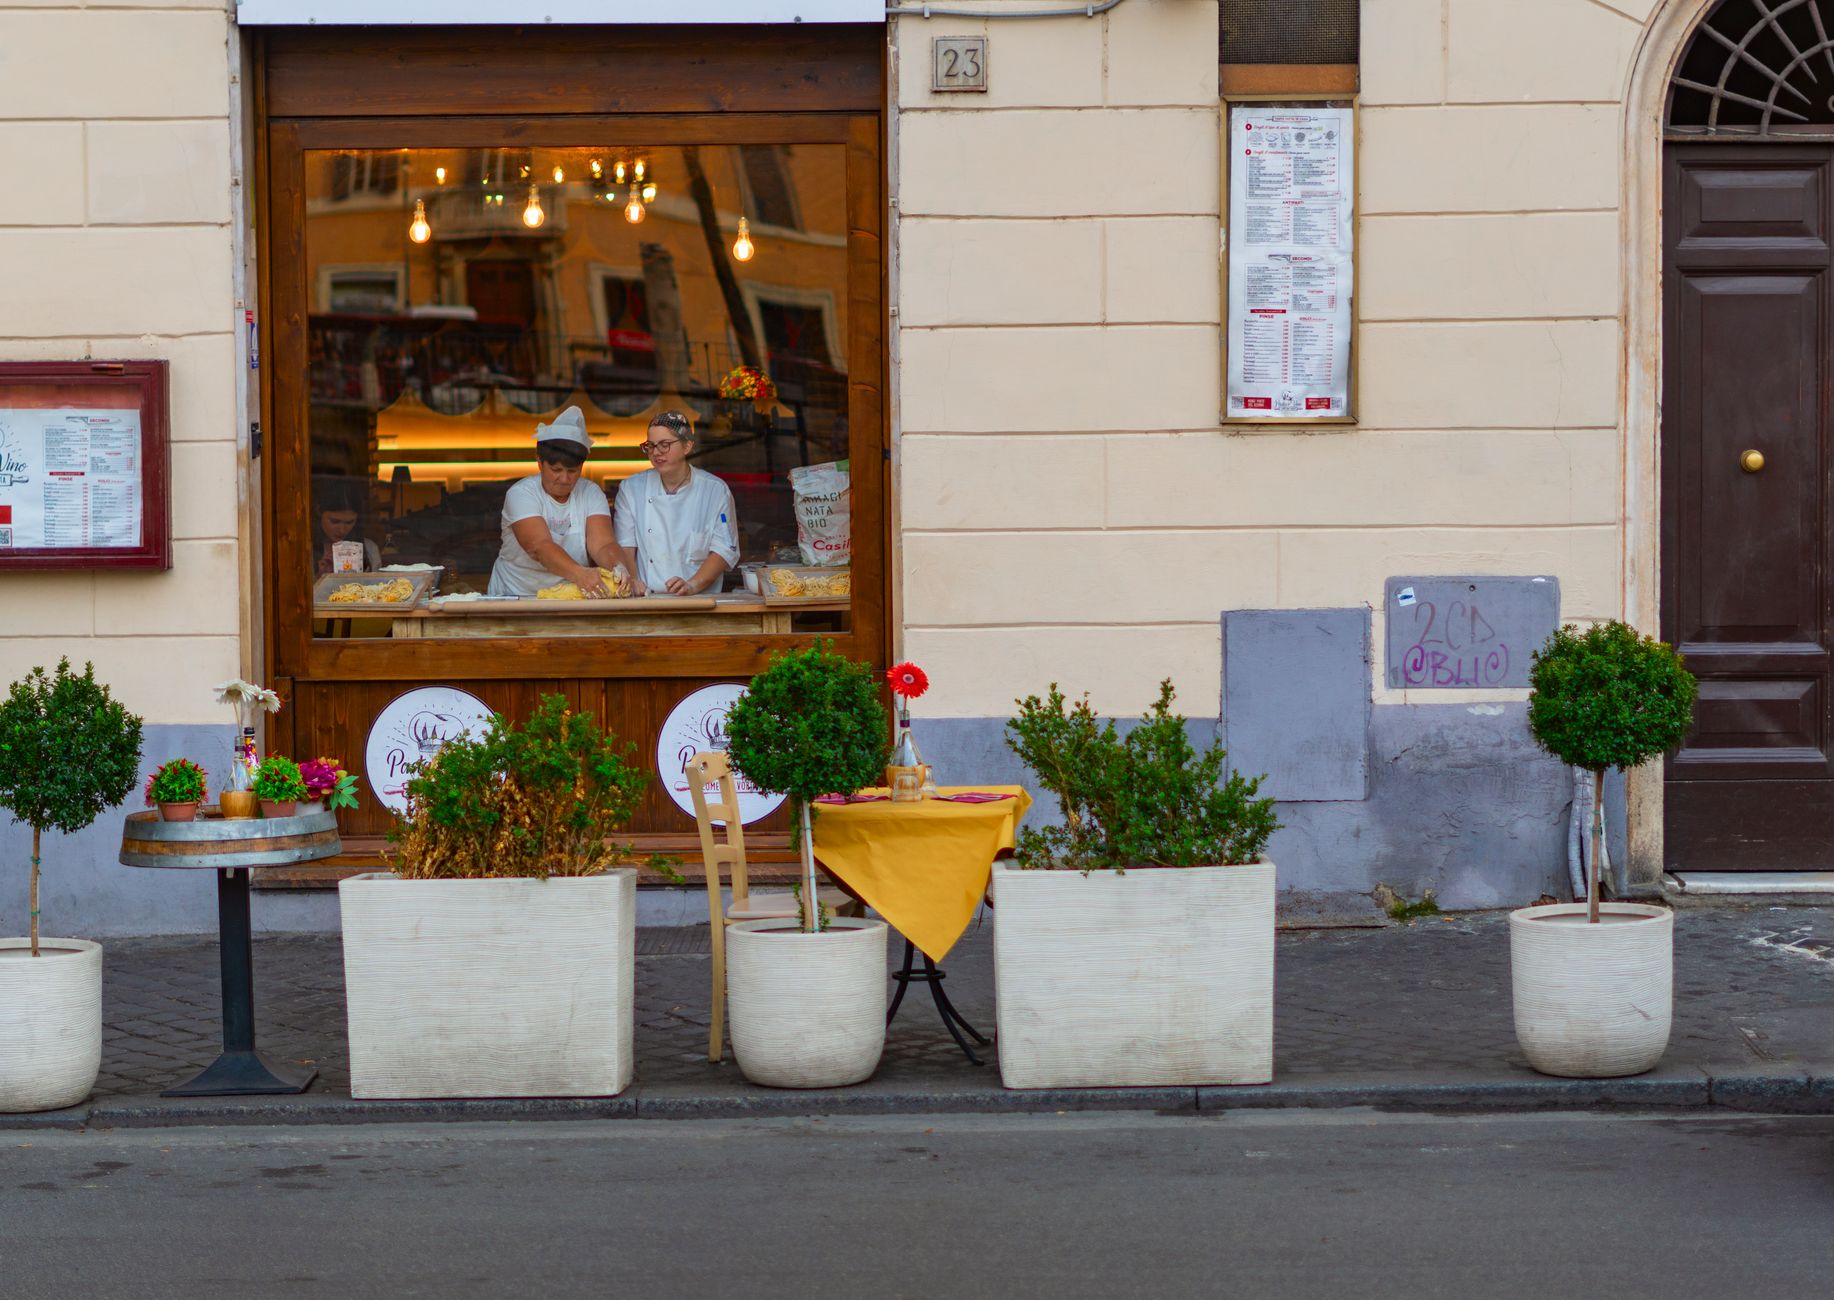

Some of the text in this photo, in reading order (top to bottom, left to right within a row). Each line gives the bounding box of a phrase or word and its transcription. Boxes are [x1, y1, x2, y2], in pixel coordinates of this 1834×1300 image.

[943, 48, 980, 78] 23
[805, 505, 833, 516] NATA
[807, 518, 827, 528] BIO
